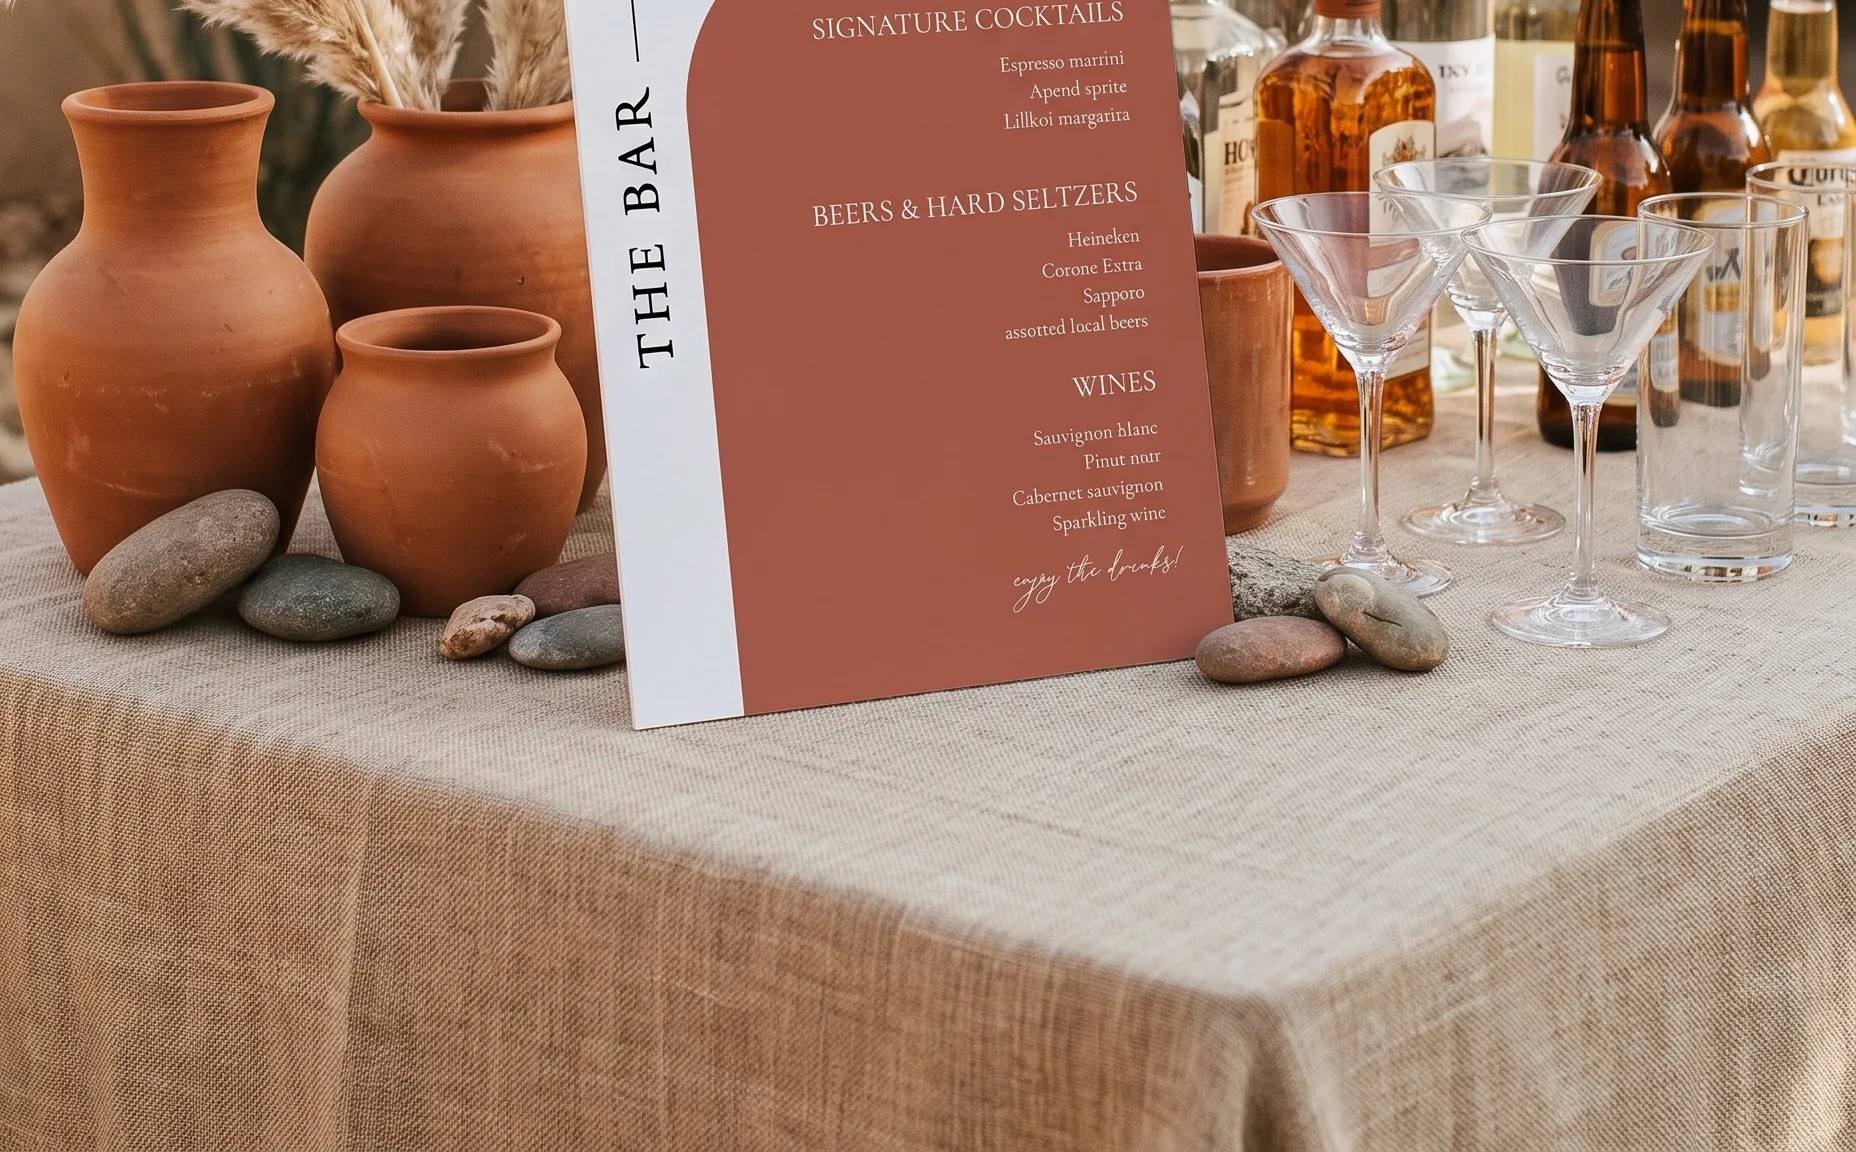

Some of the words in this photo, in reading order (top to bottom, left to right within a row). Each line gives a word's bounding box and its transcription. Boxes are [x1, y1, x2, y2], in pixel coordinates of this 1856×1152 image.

[812, 10, 968, 40] SIGNATURE
[974, 0, 1124, 30] COCKTAILS
[999, 56, 1065, 77] Espresso
[1029, 79, 1081, 105] Apend
[1085, 79, 1128, 101] sprite
[1003, 110, 1054, 130] Lillkoi
[615, 86, 661, 217] BAR
[811, 199, 894, 227] BEERS
[901, 198, 921, 220] &
[925, 191, 1005, 219] HARD
[1012, 180, 1138, 212] SELTZERS
[1066, 227, 1140, 248] Heineken
[1041, 262, 1099, 279] Corone
[1102, 257, 1144, 274] Extra
[628, 243, 675, 370] THE
[1083, 287, 1145, 308] Sapporo
[1069, 314, 1106, 334] local
[1108, 313, 1149, 331] beers
[1071, 369, 1157, 398] WINES
[1033, 428, 1114, 448] Sauvignon
[1012, 487, 1084, 507] Cabernet
[1087, 480, 1164, 500] sauvignon
[1052, 509, 1128, 537] Sparkling
